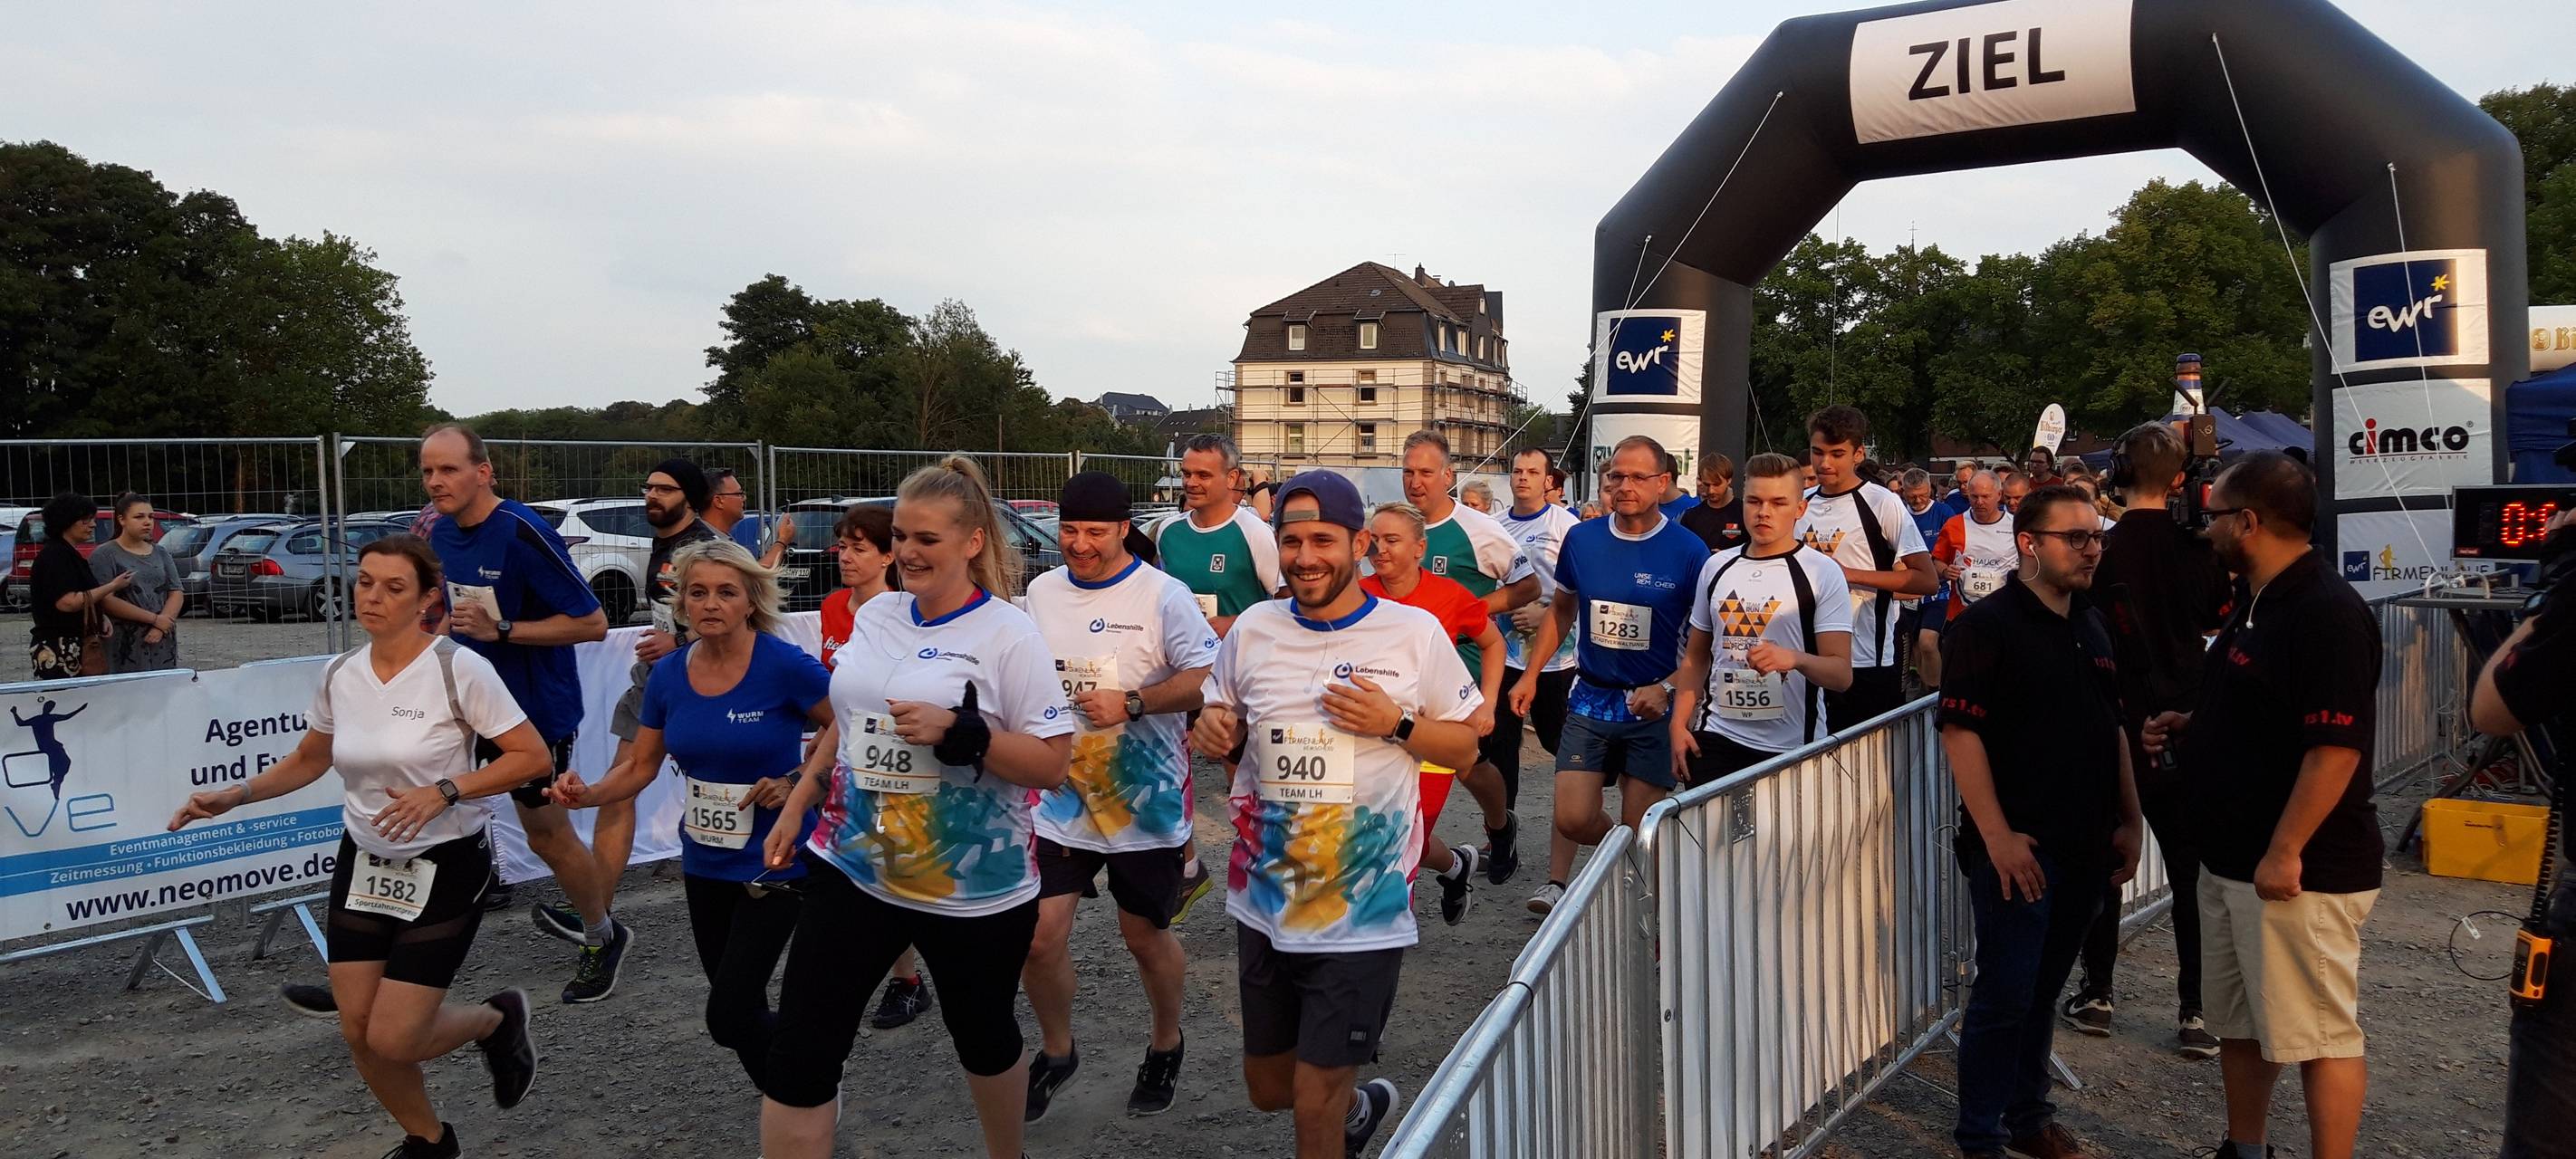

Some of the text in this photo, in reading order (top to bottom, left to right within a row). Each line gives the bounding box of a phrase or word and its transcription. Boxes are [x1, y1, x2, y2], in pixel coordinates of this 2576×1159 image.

[1908, 27, 2065, 101] ZIEL
[2367, 293, 2443, 333] ewr
[1615, 345, 1669, 374] ewr
[2348, 417, 2470, 455] cimco
[1974, 582, 1992, 590] 681
[2373, 564, 2490, 581] FIRMENLUF
[1599, 620, 1639, 638] 1283
[1355, 666, 1400, 678] Lebenshilfe
[1725, 690, 1771, 707] 1556
[391, 706, 425, 721] Sonja
[737, 710, 764, 719] WURM
[205, 712, 308, 747] Agentu
[191, 754, 246, 786] und
[865, 744, 912, 773] 948
[1277, 754, 1326, 781] 940
[864, 777, 909, 790] TEAM LH
[1280, 788, 1323, 799] TEAM LH
[692, 806, 737, 831] 1565
[110, 814, 297, 857] Eventmanagement & -service
[50, 860, 144, 884] Zeitmessung
[154, 836, 288, 868] Funktionsbekleidung
[66, 852, 336, 921] www.neomove.de
[366, 876, 417, 903] 1582
